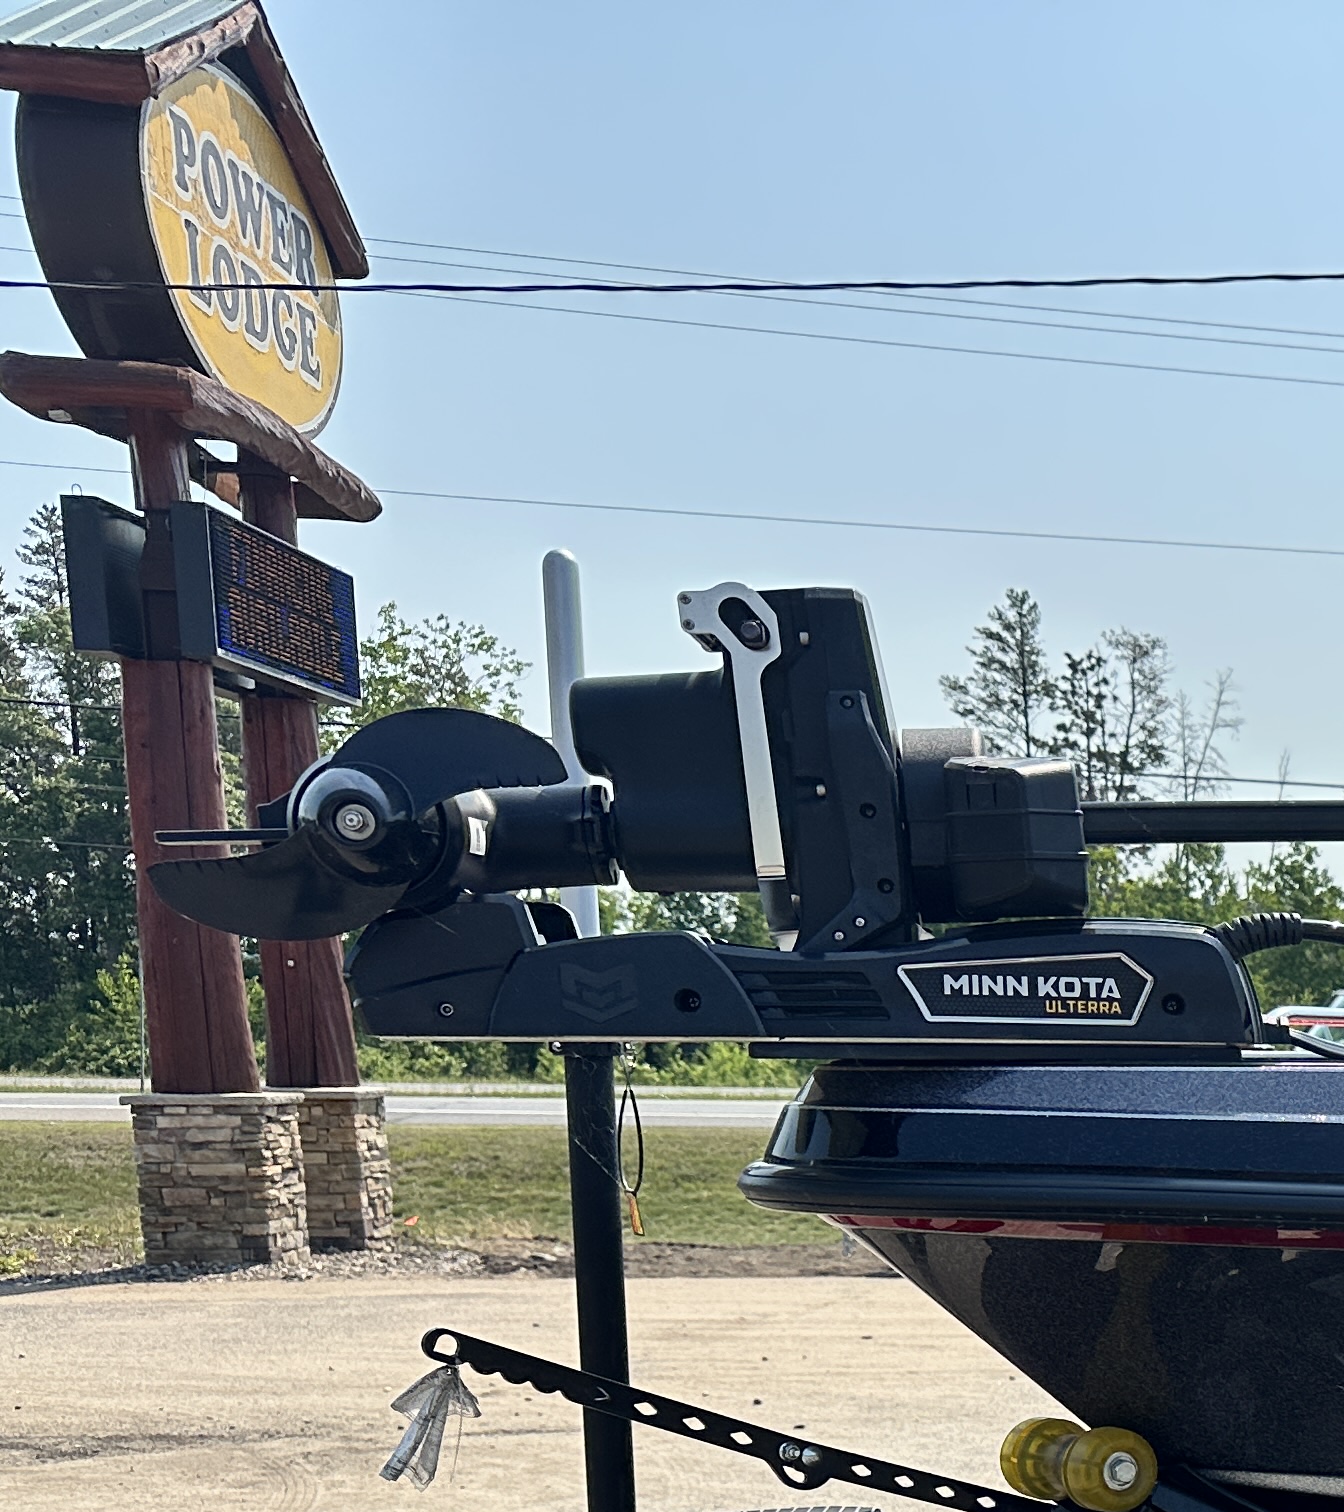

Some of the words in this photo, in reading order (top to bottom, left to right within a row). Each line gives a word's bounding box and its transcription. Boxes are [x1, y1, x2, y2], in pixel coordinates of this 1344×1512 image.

[167, 104, 321, 298] POWER
[182, 215, 322, 389] LODGE
[943, 973, 1029, 997] MINN
[1037, 975, 1121, 999] KOTA
[1045, 1000, 1122, 1014] ULTERRA
